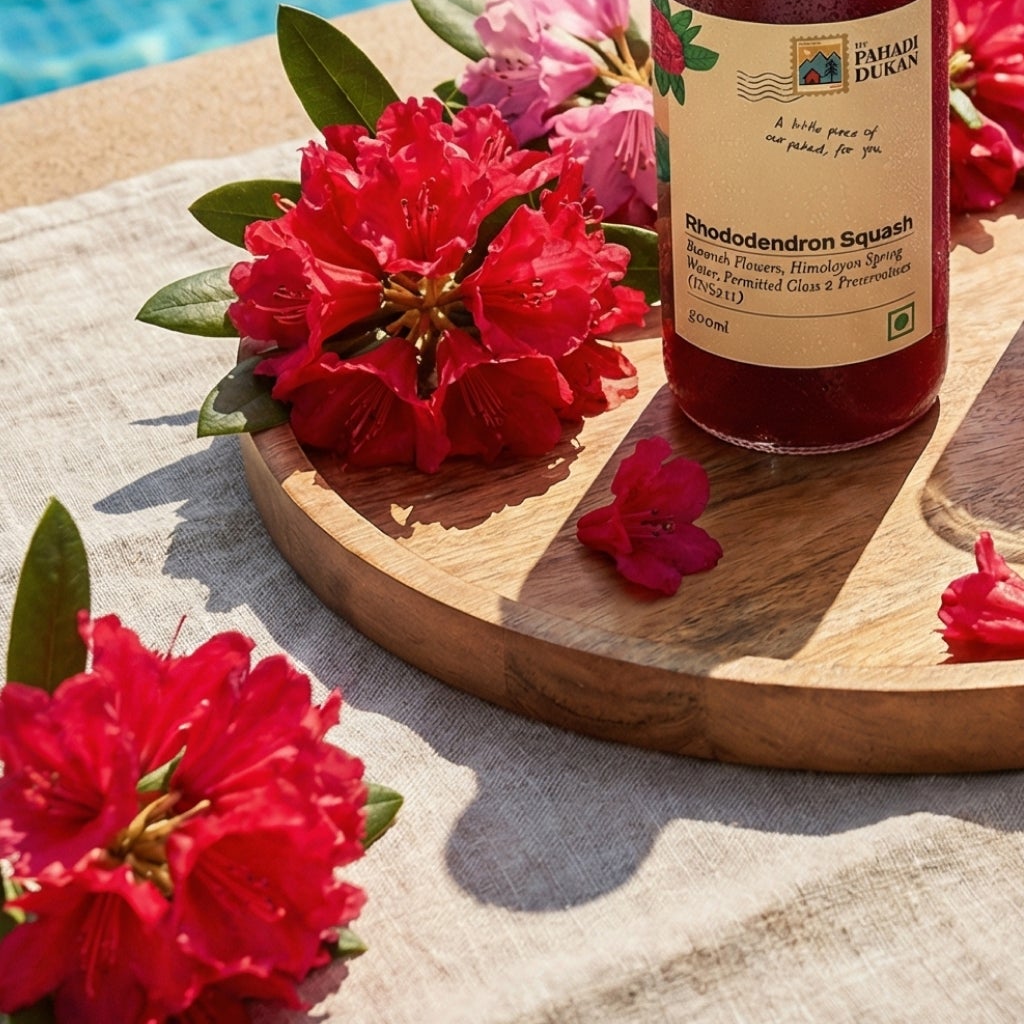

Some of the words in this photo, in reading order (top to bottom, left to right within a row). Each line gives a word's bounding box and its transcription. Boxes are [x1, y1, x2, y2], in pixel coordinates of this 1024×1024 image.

[855, 35, 918, 65] PAHADI
[855, 51, 918, 82] DUKAN
[775, 116, 783, 128] A
[864, 125, 879, 141] of
[685, 213, 835, 252] Rhododendron
[840, 215, 914, 249] Squash
[724, 271, 783, 291] Permitted
[825, 281, 833, 292] 2
